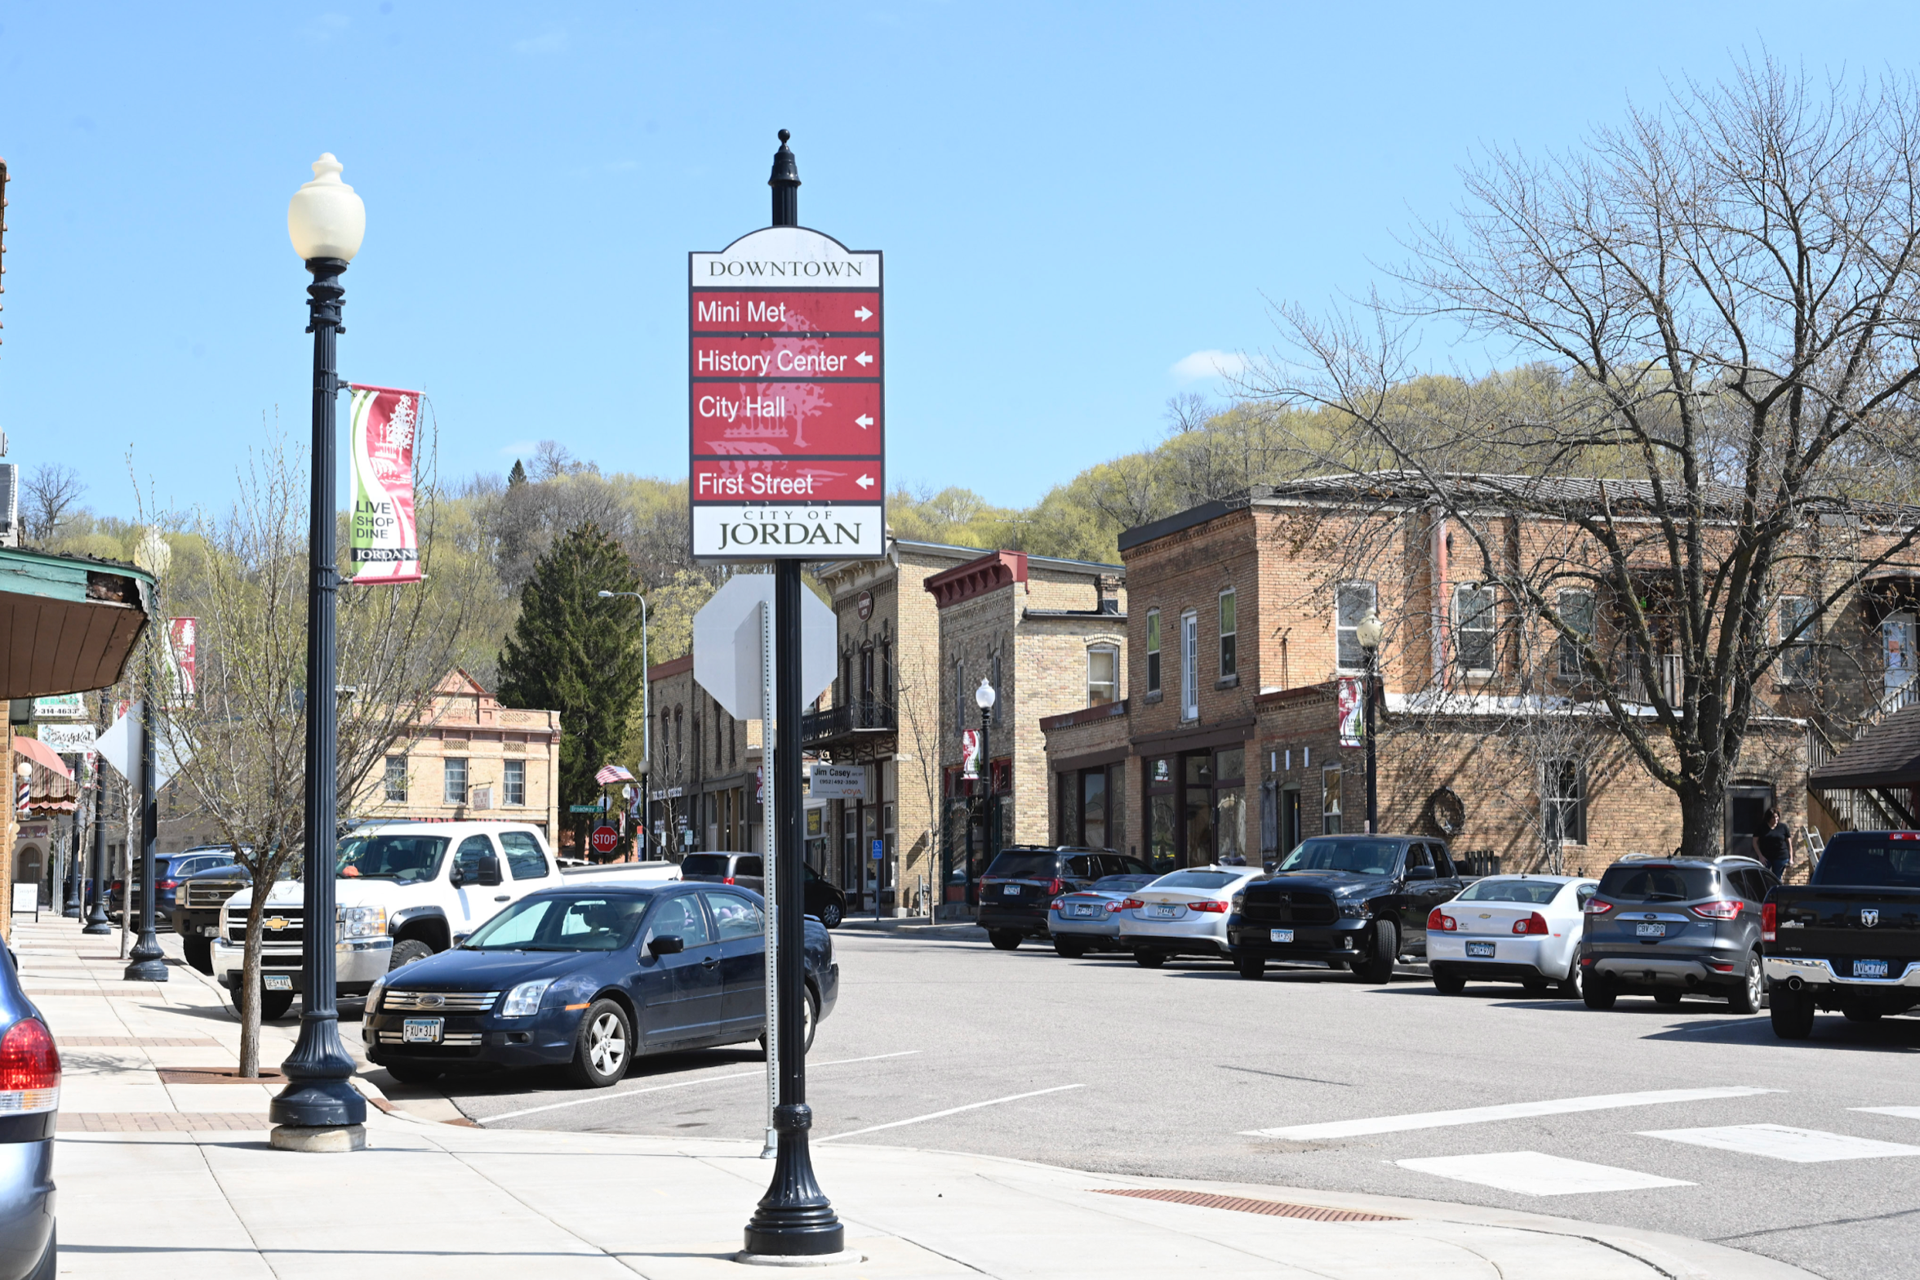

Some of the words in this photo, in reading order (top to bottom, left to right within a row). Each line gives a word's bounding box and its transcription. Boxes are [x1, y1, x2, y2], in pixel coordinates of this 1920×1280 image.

[709, 261, 863, 277] DOWNTOWN
[698, 301, 740, 322] Mini
[747, 301, 786, 322] Met
[698, 350, 771, 376] History
[777, 350, 848, 372] Center
[699, 396, 739, 423] City
[747, 396, 785, 417] Hall
[699, 473, 745, 495] First
[750, 473, 814, 495] Street
[356, 500, 390, 514] LIVE
[356, 516, 394, 527] SHOP
[743, 510, 793, 520] CITY
[808, 510, 832, 520] OF
[356, 528, 388, 539] DINE
[718, 523, 862, 550] JORDAN
[356, 549, 413, 561] JORDAN
[814, 768, 828, 776] Jim
[829, 768, 851, 778] Casey
[593, 834, 617, 844] STOP
